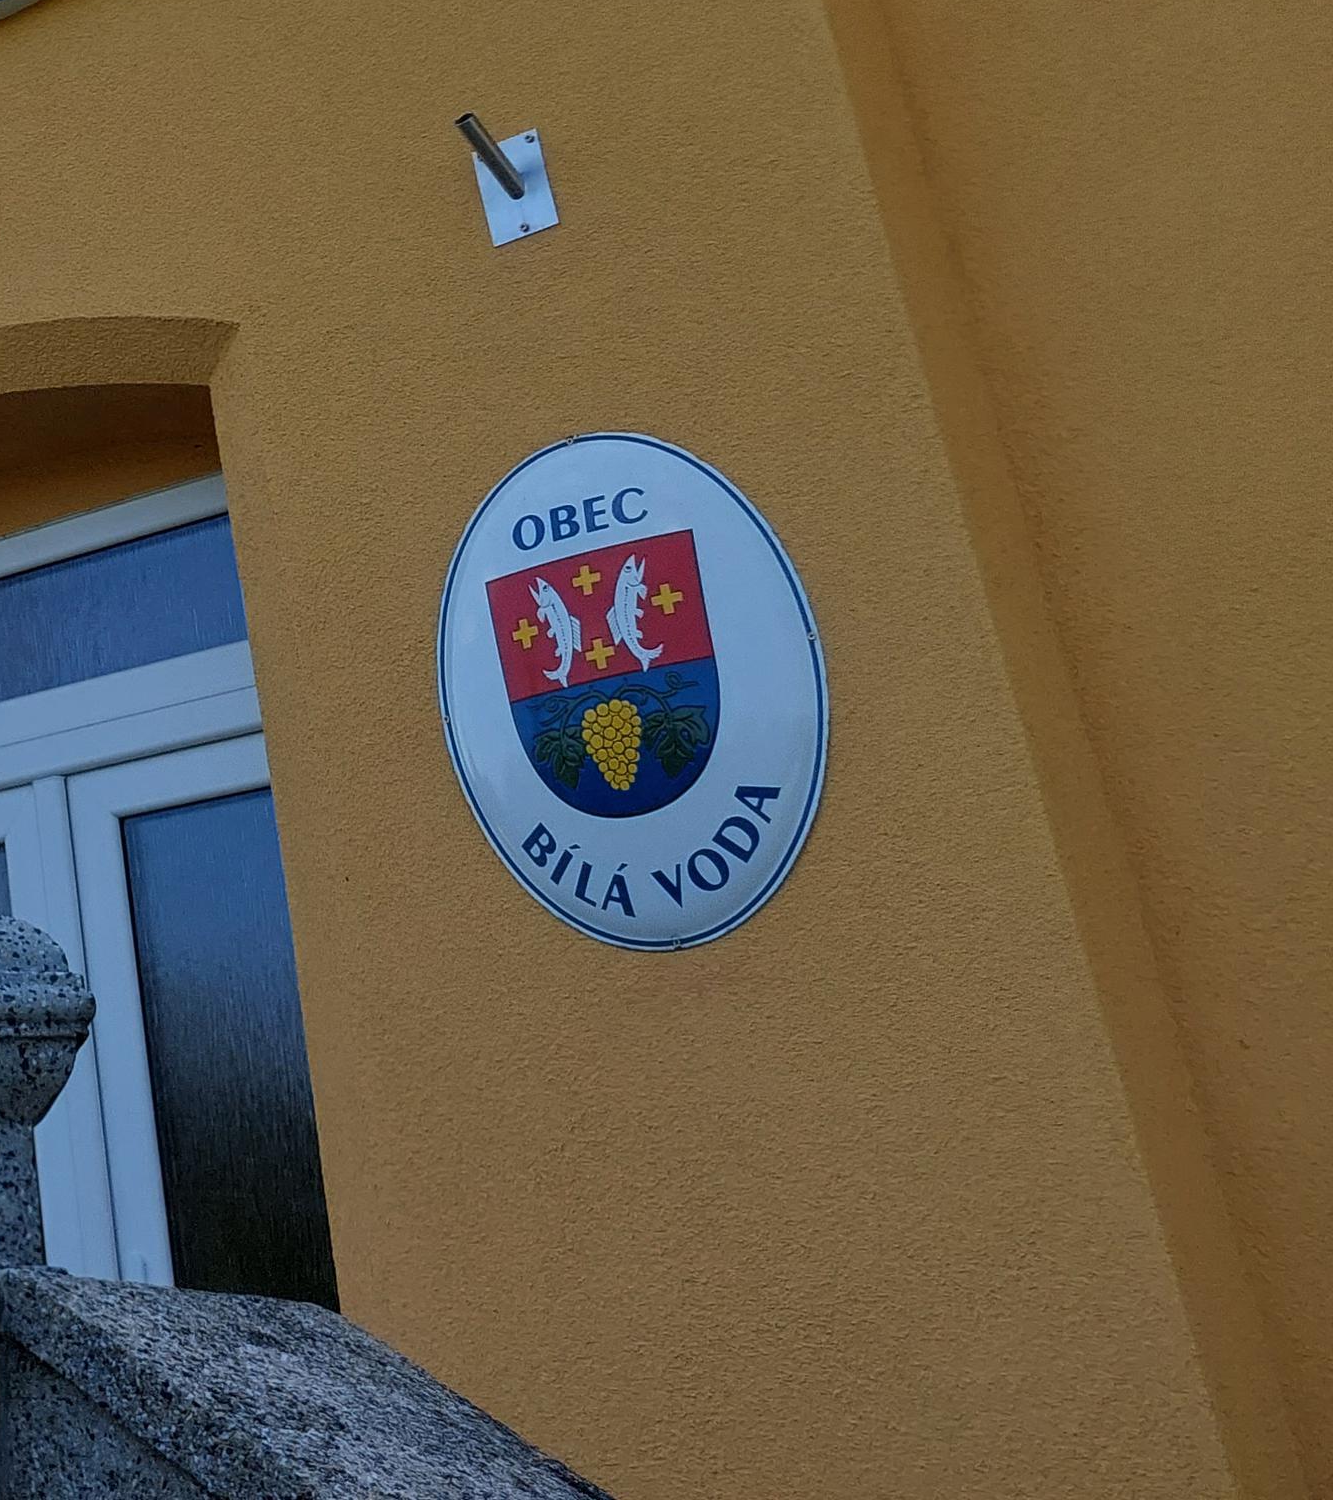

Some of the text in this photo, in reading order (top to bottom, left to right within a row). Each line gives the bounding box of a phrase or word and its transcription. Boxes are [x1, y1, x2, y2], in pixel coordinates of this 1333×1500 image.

[512, 487, 649, 551] OBEC
[521, 784, 782, 918] BÍLÁ VODA
